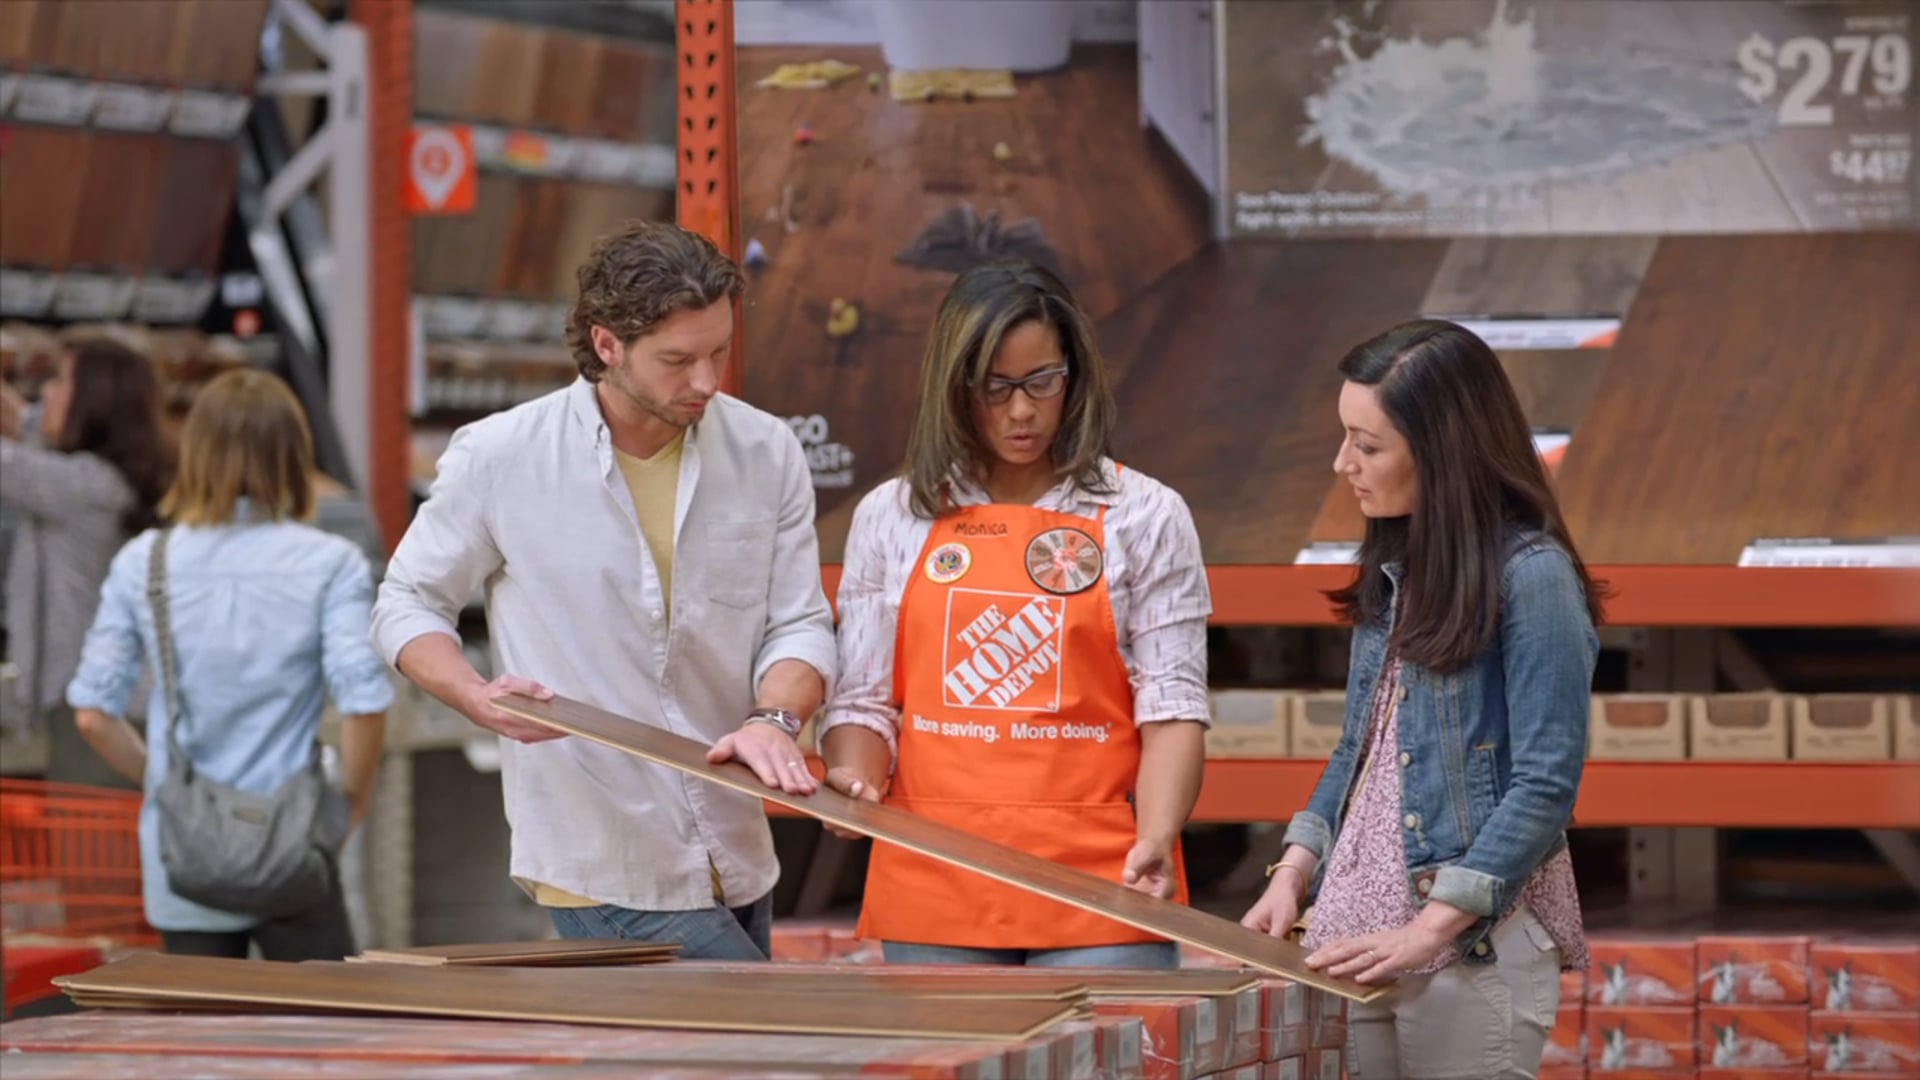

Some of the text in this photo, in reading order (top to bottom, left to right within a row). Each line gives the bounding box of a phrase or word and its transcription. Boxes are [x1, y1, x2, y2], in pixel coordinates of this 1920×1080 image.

[954, 522, 1008, 536] Monica
[957, 603, 1007, 650] THE
[945, 596, 1063, 706] HOME
[987, 640, 1060, 708] DEPOT
[912, 714, 939, 734] More
[941, 721, 1000, 743] saving.
[1010, 722, 1057, 740] More
